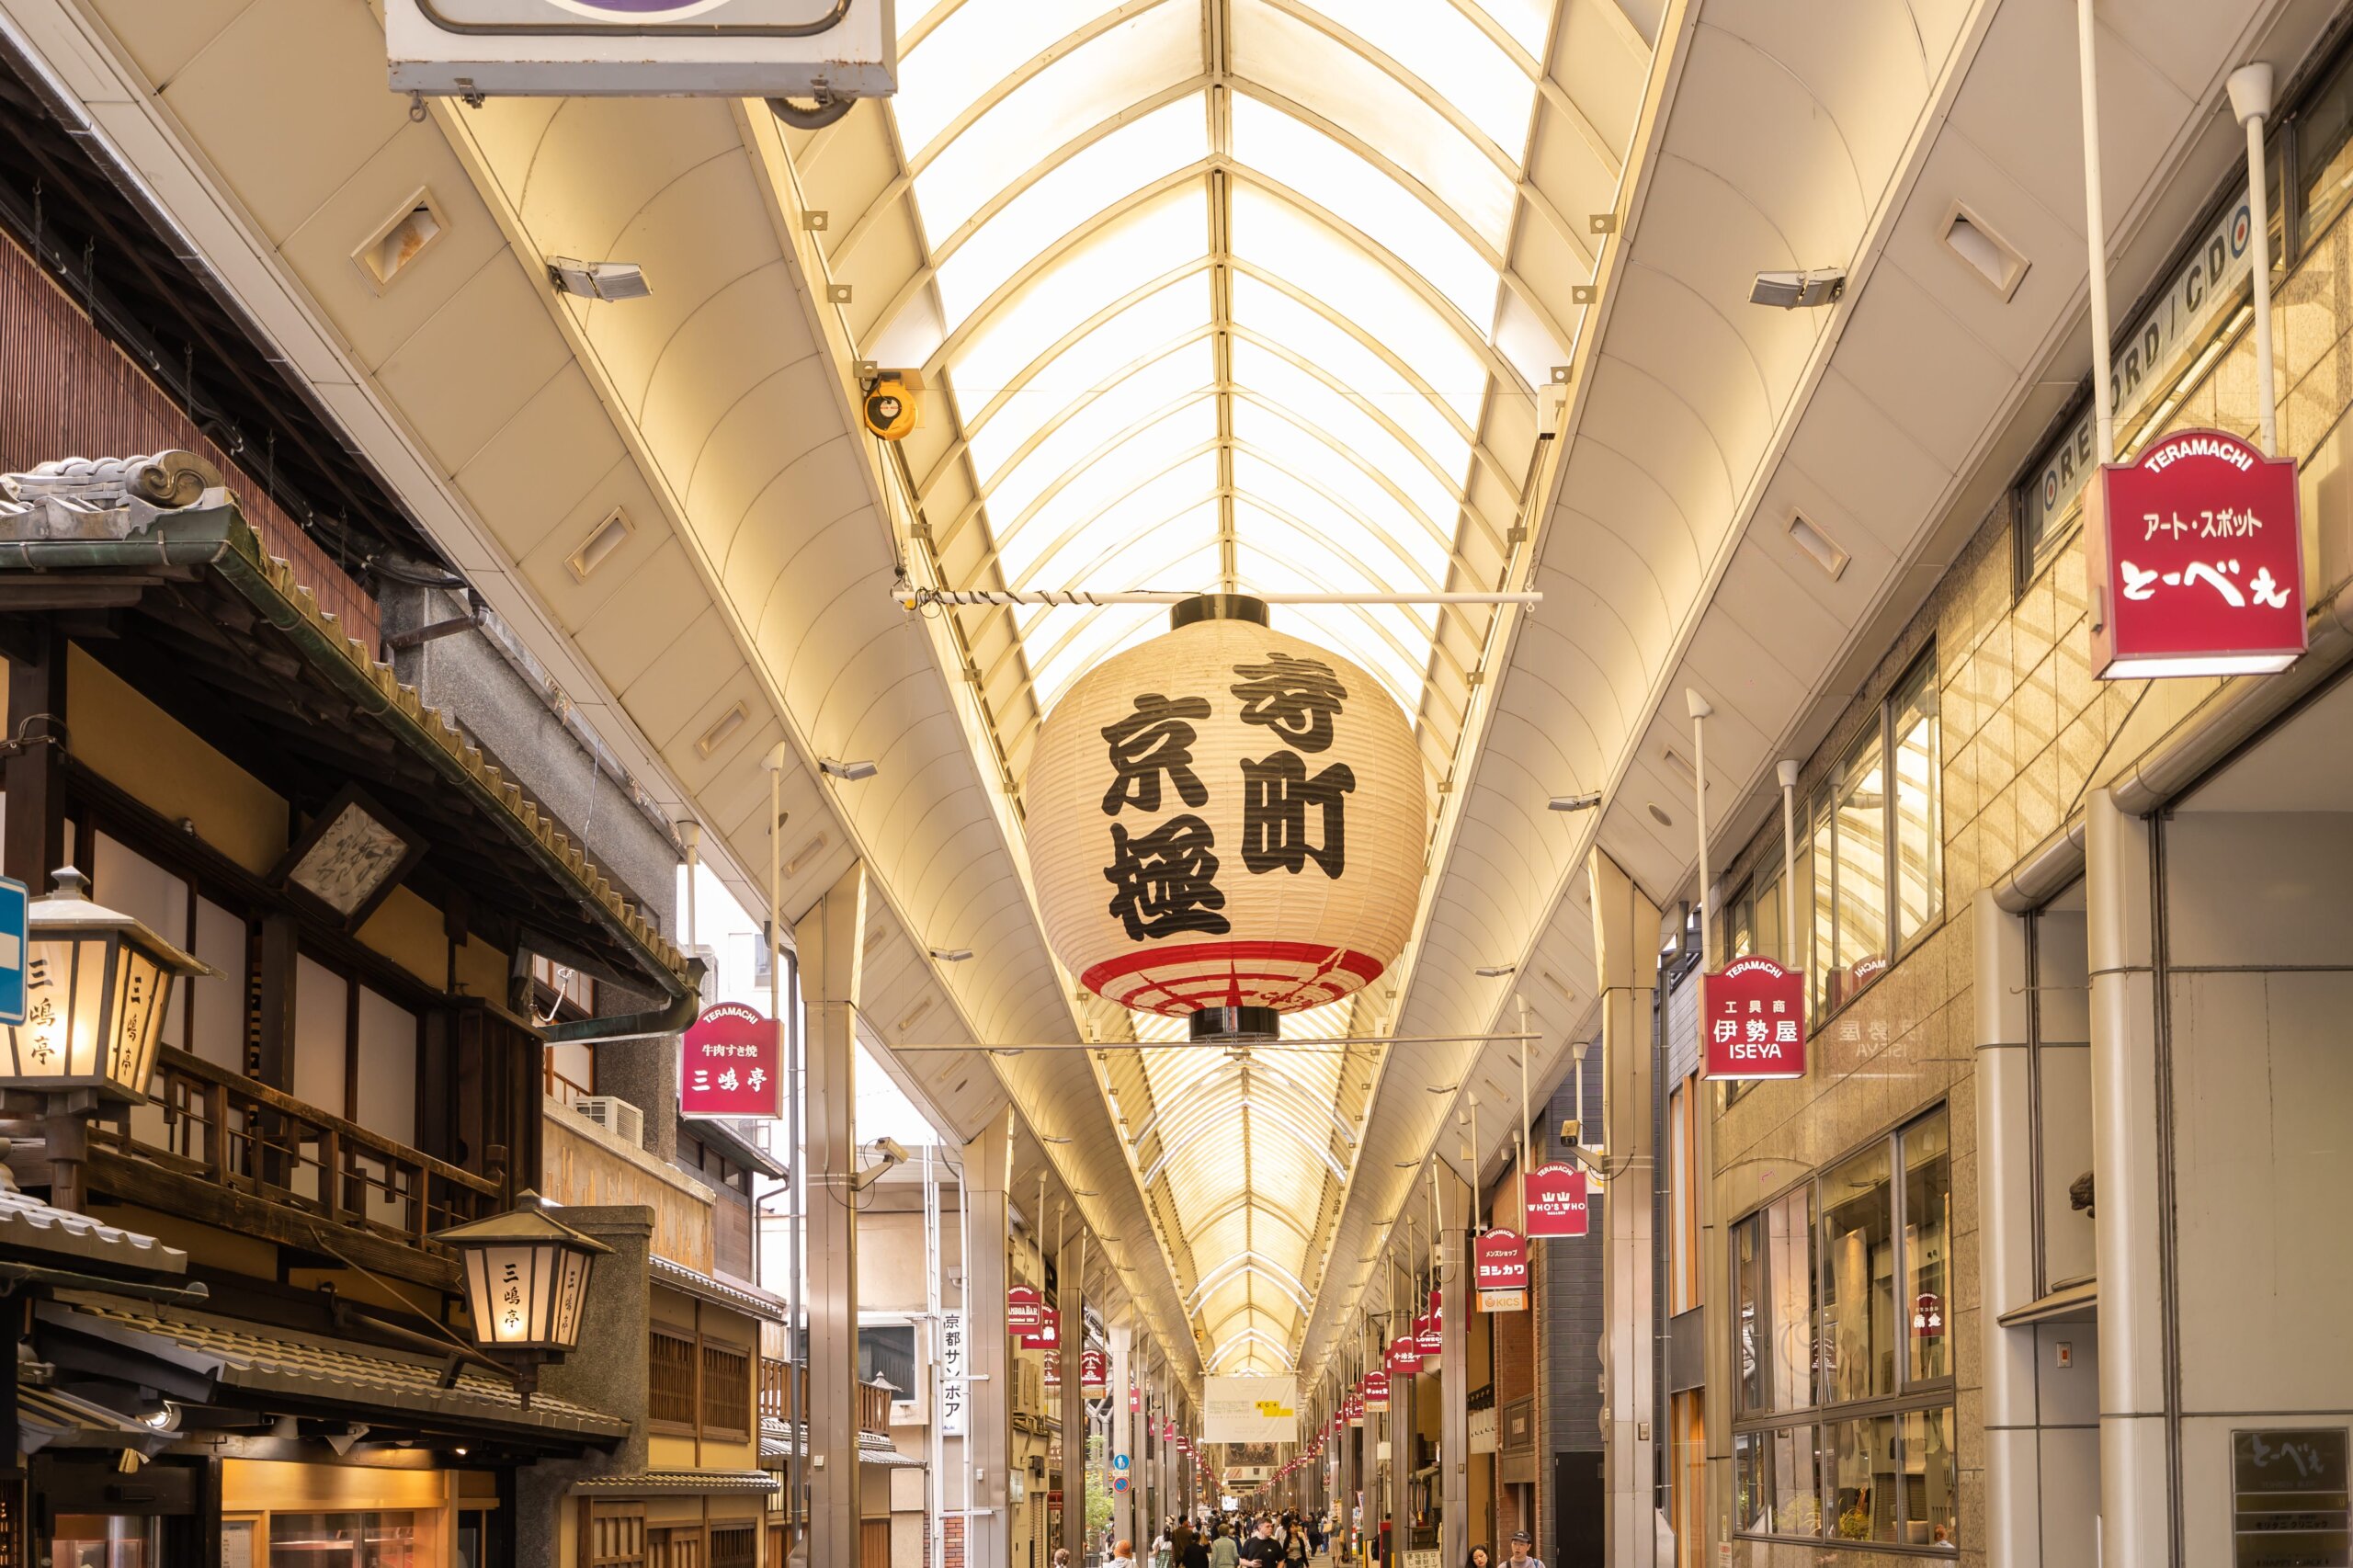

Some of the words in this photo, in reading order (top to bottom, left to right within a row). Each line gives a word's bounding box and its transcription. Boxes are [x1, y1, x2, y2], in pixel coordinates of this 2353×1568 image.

[2143, 438, 2255, 473] TERAMACHI
[2143, 507, 2263, 541] アート・スポット
[1230, 653, 1356, 880] 寺町
[1101, 693, 1231, 942] 京極
[1725, 960, 1783, 979] TERAMACHI
[28, 959, 56, 1065] 三嶋亭
[702, 1006, 759, 1025] TERAMACHI
[1724, 1000, 1786, 1014] 工具商
[1713, 1019, 1798, 1043] 伊勢屋
[701, 1044, 758, 1058] 牛肉すき焼
[1729, 1044, 1782, 1059] ISEYA
[691, 1066, 767, 1093] 三嶋亭
[1537, 1165, 1574, 1177] TERAMACHI
[1528, 1203, 1560, 1211] WHO'S
[1562, 1202, 1586, 1210] WHO
[1486, 1229, 1516, 1240] TERAMACHI
[1485, 1249, 1518, 1257] メンズショップ
[1480, 1264, 1524, 1276] ヨシカワ
[503, 1263, 520, 1329] 三嶋亭
[1496, 1297, 1520, 1306] KICS
